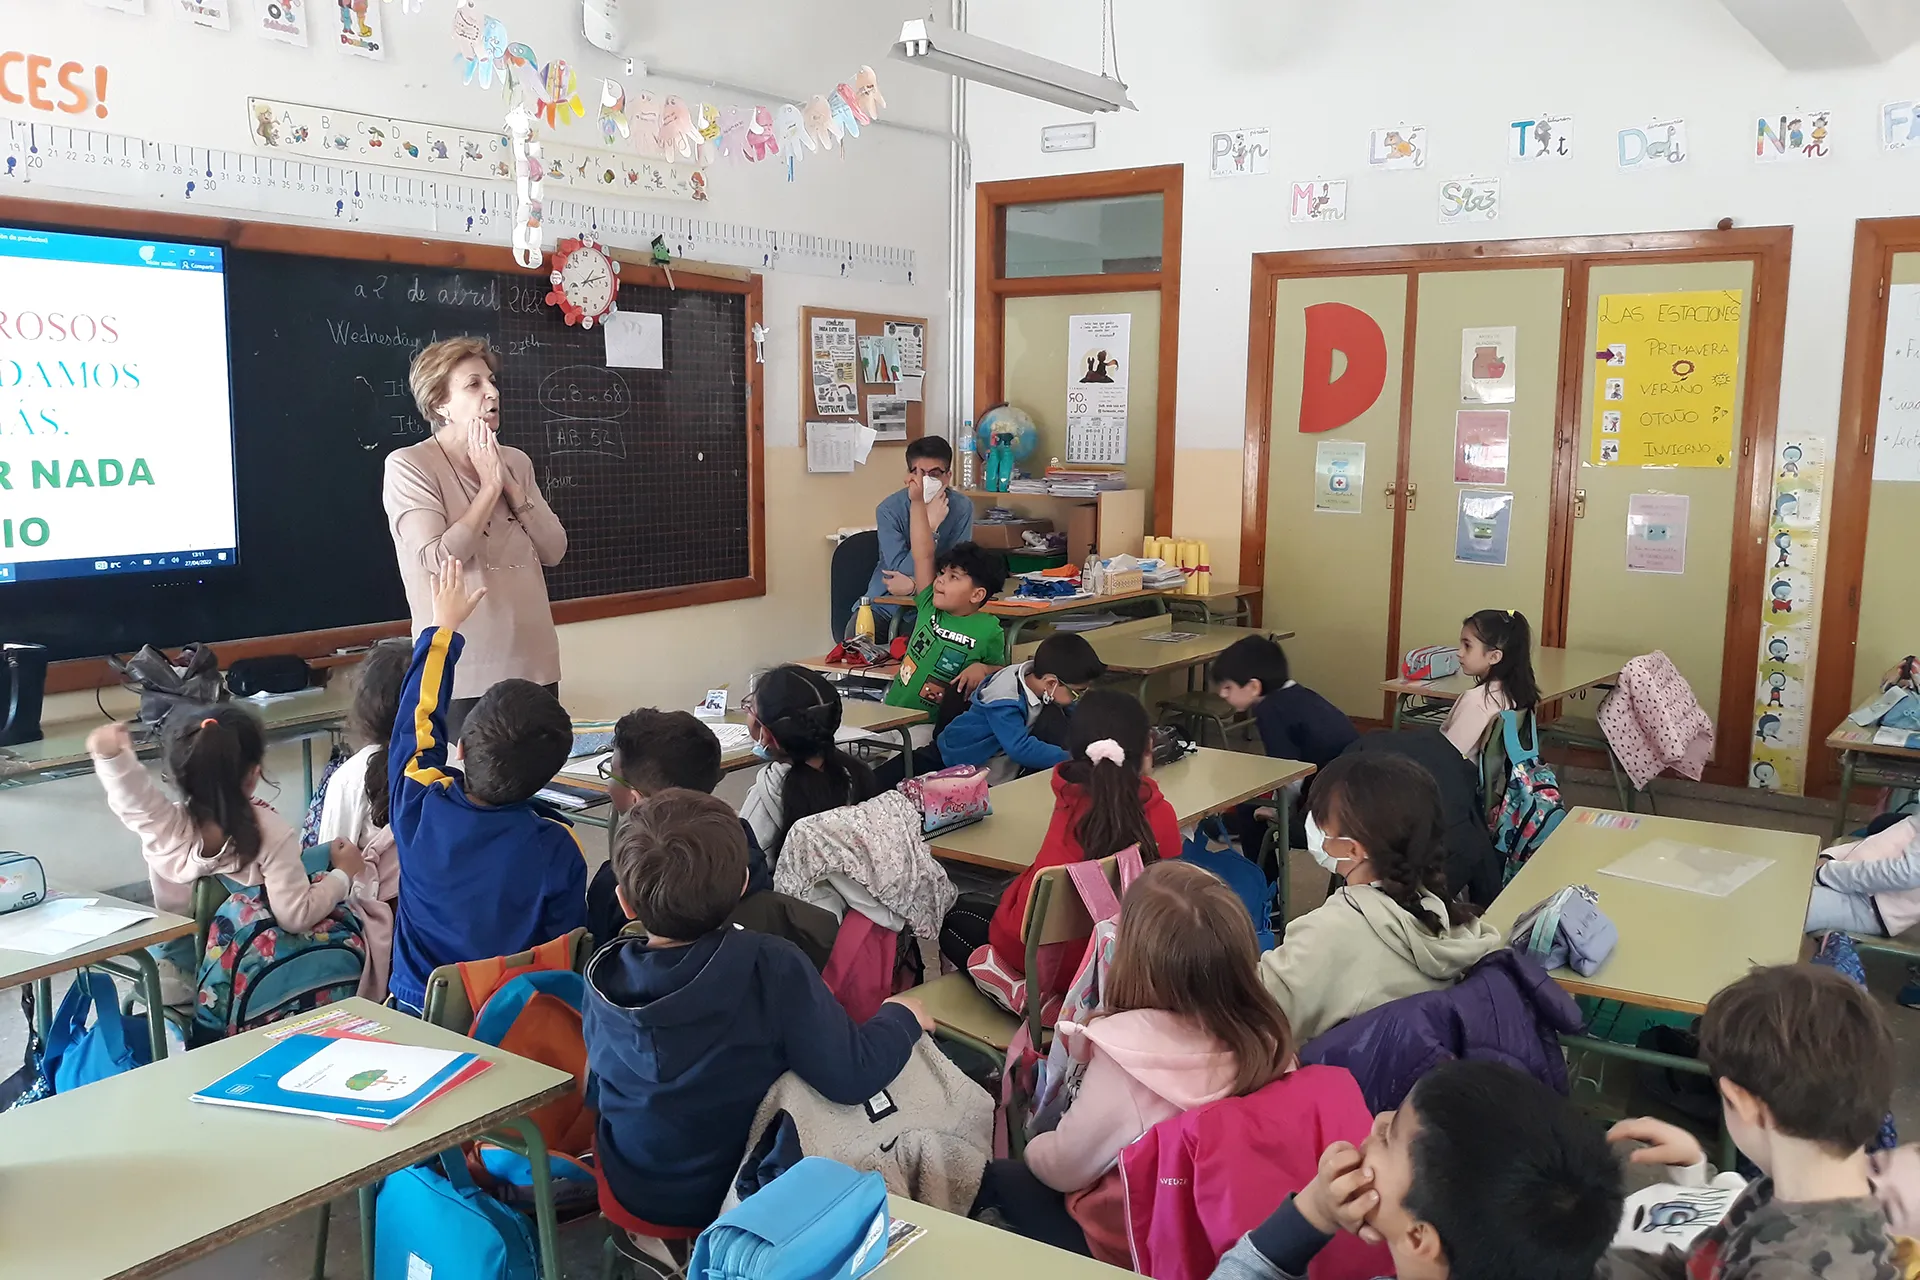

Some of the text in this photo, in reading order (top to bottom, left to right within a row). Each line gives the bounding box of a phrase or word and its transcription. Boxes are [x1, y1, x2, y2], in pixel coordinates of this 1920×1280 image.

[340, 34, 380, 52] Domingo
[282, 111, 677, 178] A B C D E F G I J K L M N
[1212, 134, 1232, 170] P
[1370, 131, 1388, 164] L
[1510, 120, 1568, 156] T t
[1618, 128, 1648, 166] D
[1756, 116, 1828, 158] N n
[10, 142, 20, 152] 19
[28, 156, 42, 168] 20
[48, 148, 58, 158] 21
[66, 151, 77, 160] 22
[84, 154, 96, 163] 23
[103, 156, 114, 166] 24
[120, 158, 132, 168] 25
[138, 160, 150, 170] 26
[156, 163, 166, 172] 27
[172, 166, 182, 174] 28
[188, 168, 198, 176] 29
[204, 179, 216, 190] 30
[220, 172, 230, 180] 31
[236, 174, 246, 183] 32
[252, 176, 262, 185] 33
[267, 178, 276, 187] 34
[282, 180, 290, 189] 35
[296, 182, 306, 191] 36
[310, 184, 320, 192] 37
[325, 186, 334, 194] 38
[338, 188, 348, 196] 39
[352, 198, 364, 209] 40
[366, 192, 375, 200] 41
[380, 194, 388, 202] 42
[479, 215, 490, 225] 50
[1292, 183, 1314, 216] M
[1440, 182, 1463, 216] S
[407, 277, 428, 302] de
[438, 274, 500, 311] abril
[1600, 298, 1741, 324] LAS ESTACIONES
[1644, 338, 1730, 356] PRIMAVERA
[1299, 302, 1388, 432] D
[604, 384, 622, 402] 68
[1640, 382, 1704, 396] VERANO
[0, 398, 69, 435] ÁS.
[1640, 409, 1700, 426] OTOÑO
[557, 427, 616, 446] AB 52
[1644, 442, 1712, 458] INVIERNO
[31, 458, 156, 489] NADA
[184, 558, 212, 568] 27/04/2022
